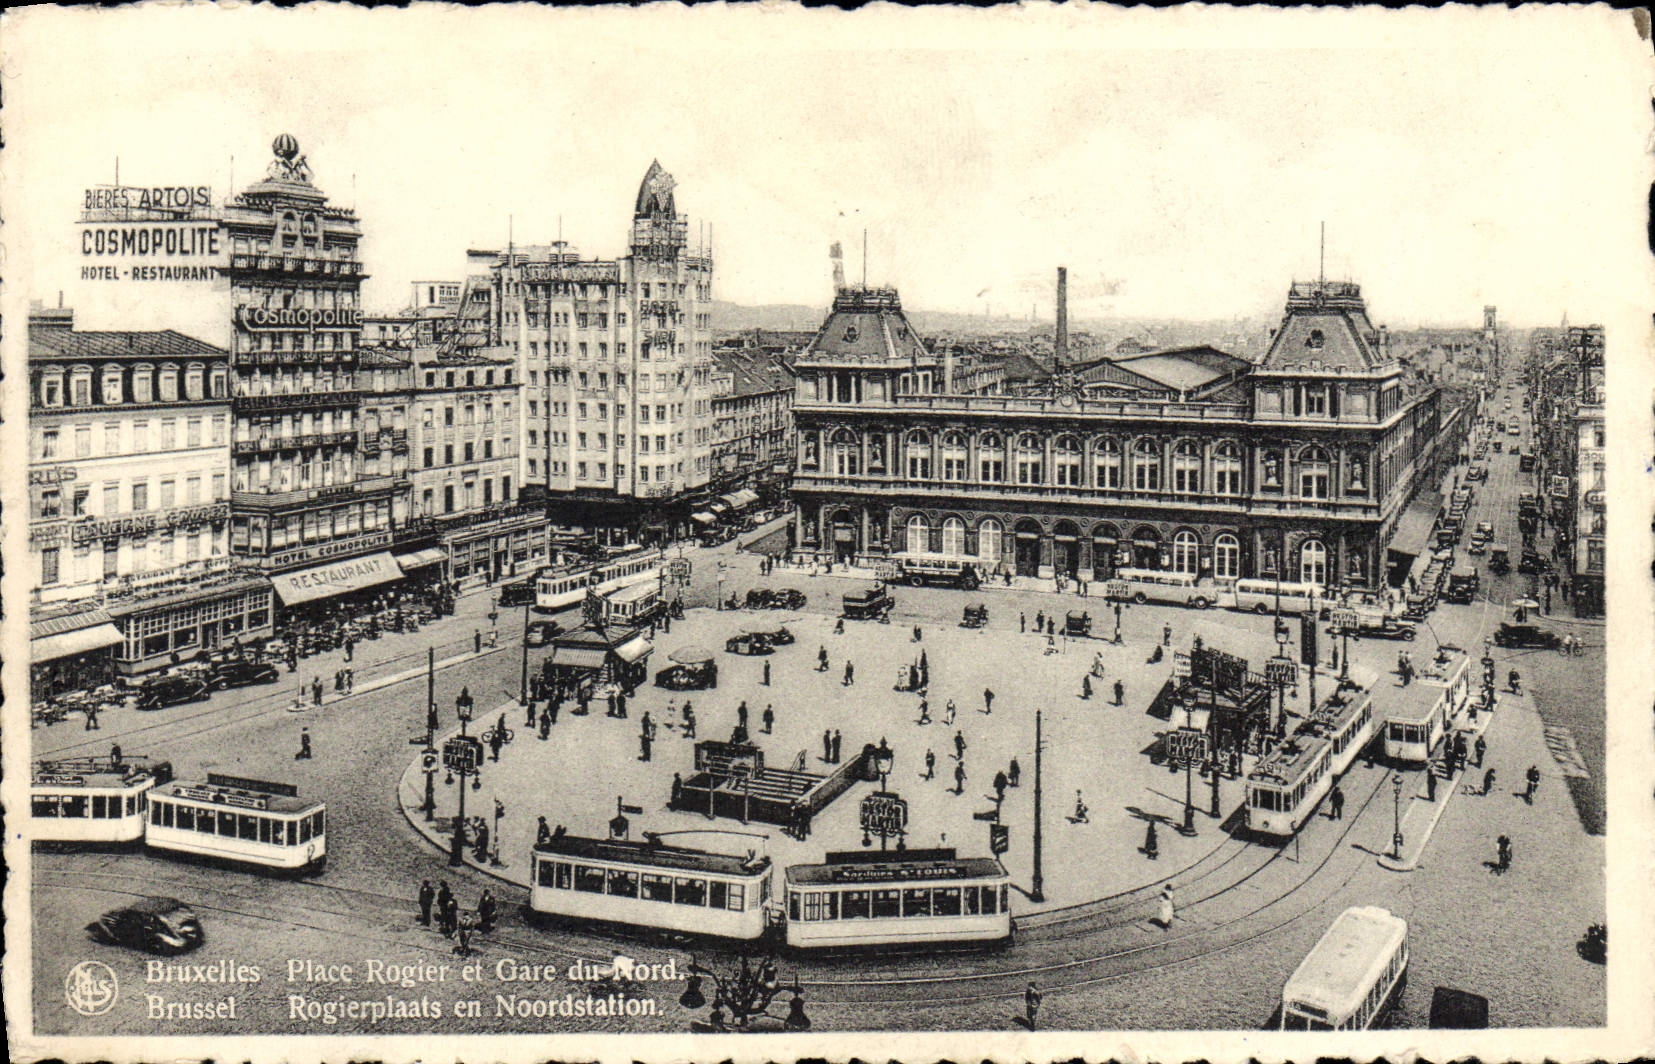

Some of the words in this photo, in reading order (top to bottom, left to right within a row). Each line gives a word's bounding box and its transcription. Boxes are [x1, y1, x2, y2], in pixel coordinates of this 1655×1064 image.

[85, 188, 129, 209] BIERES
[139, 186, 209, 209] ARTOIS
[81, 227, 219, 256] COSMOPOLITE
[80, 265, 119, 281] HOTEL
[131, 265, 216, 281] RESTAURANT
[243, 302, 363, 333] Cosmopolite
[75, 514, 157, 539] TAVERNE
[274, 552, 312, 565] HOTEL
[318, 536, 389, 555] COSMOPOLITE
[289, 560, 381, 590] RESTAURANT
[861, 800, 901, 815] NESTOR
[842, 870, 894, 878] Sardines
